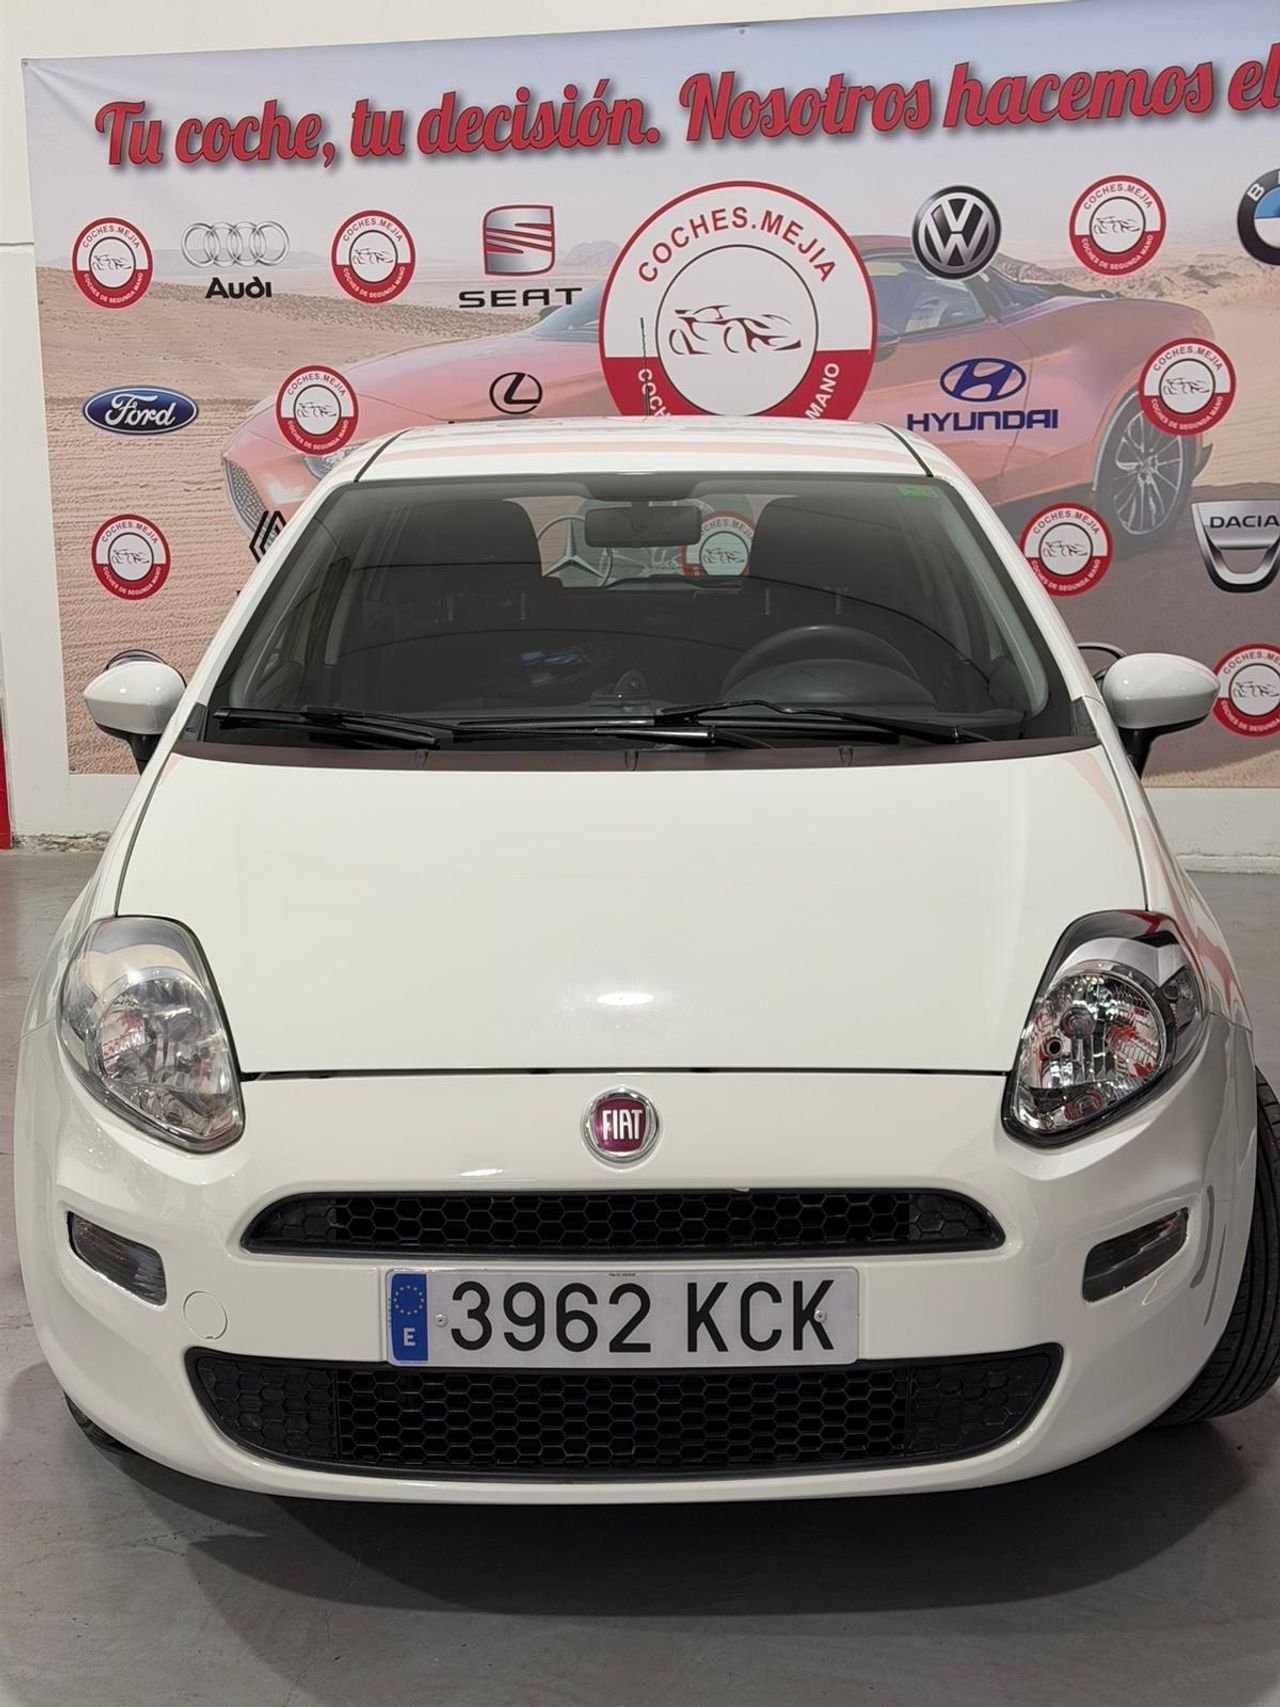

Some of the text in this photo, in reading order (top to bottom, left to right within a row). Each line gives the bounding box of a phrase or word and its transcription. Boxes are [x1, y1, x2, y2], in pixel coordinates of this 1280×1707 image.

[95, 101, 164, 165] Tu
[175, 99, 336, 168] coche,
[350, 98, 405, 157] tu
[417, 78, 660, 155] decisión.
[679, 71, 930, 142] Nosotros
[943, 61, 1213, 128] hacemos
[638, 206, 836, 282] COCHES.MEJIA
[205, 276, 272, 299] Audi
[459, 287, 582, 308] SEAT
[805, 362, 840, 419] MANO
[105, 393, 177, 425] Ford
[907, 409, 1058, 432] HYUNDAI
[1210, 514, 1280, 528] DACIA
[602, 1109, 643, 1141] FIAT
[450, 1280, 835, 1353] 3962 KCK
[403, 1327, 416, 1347] E
